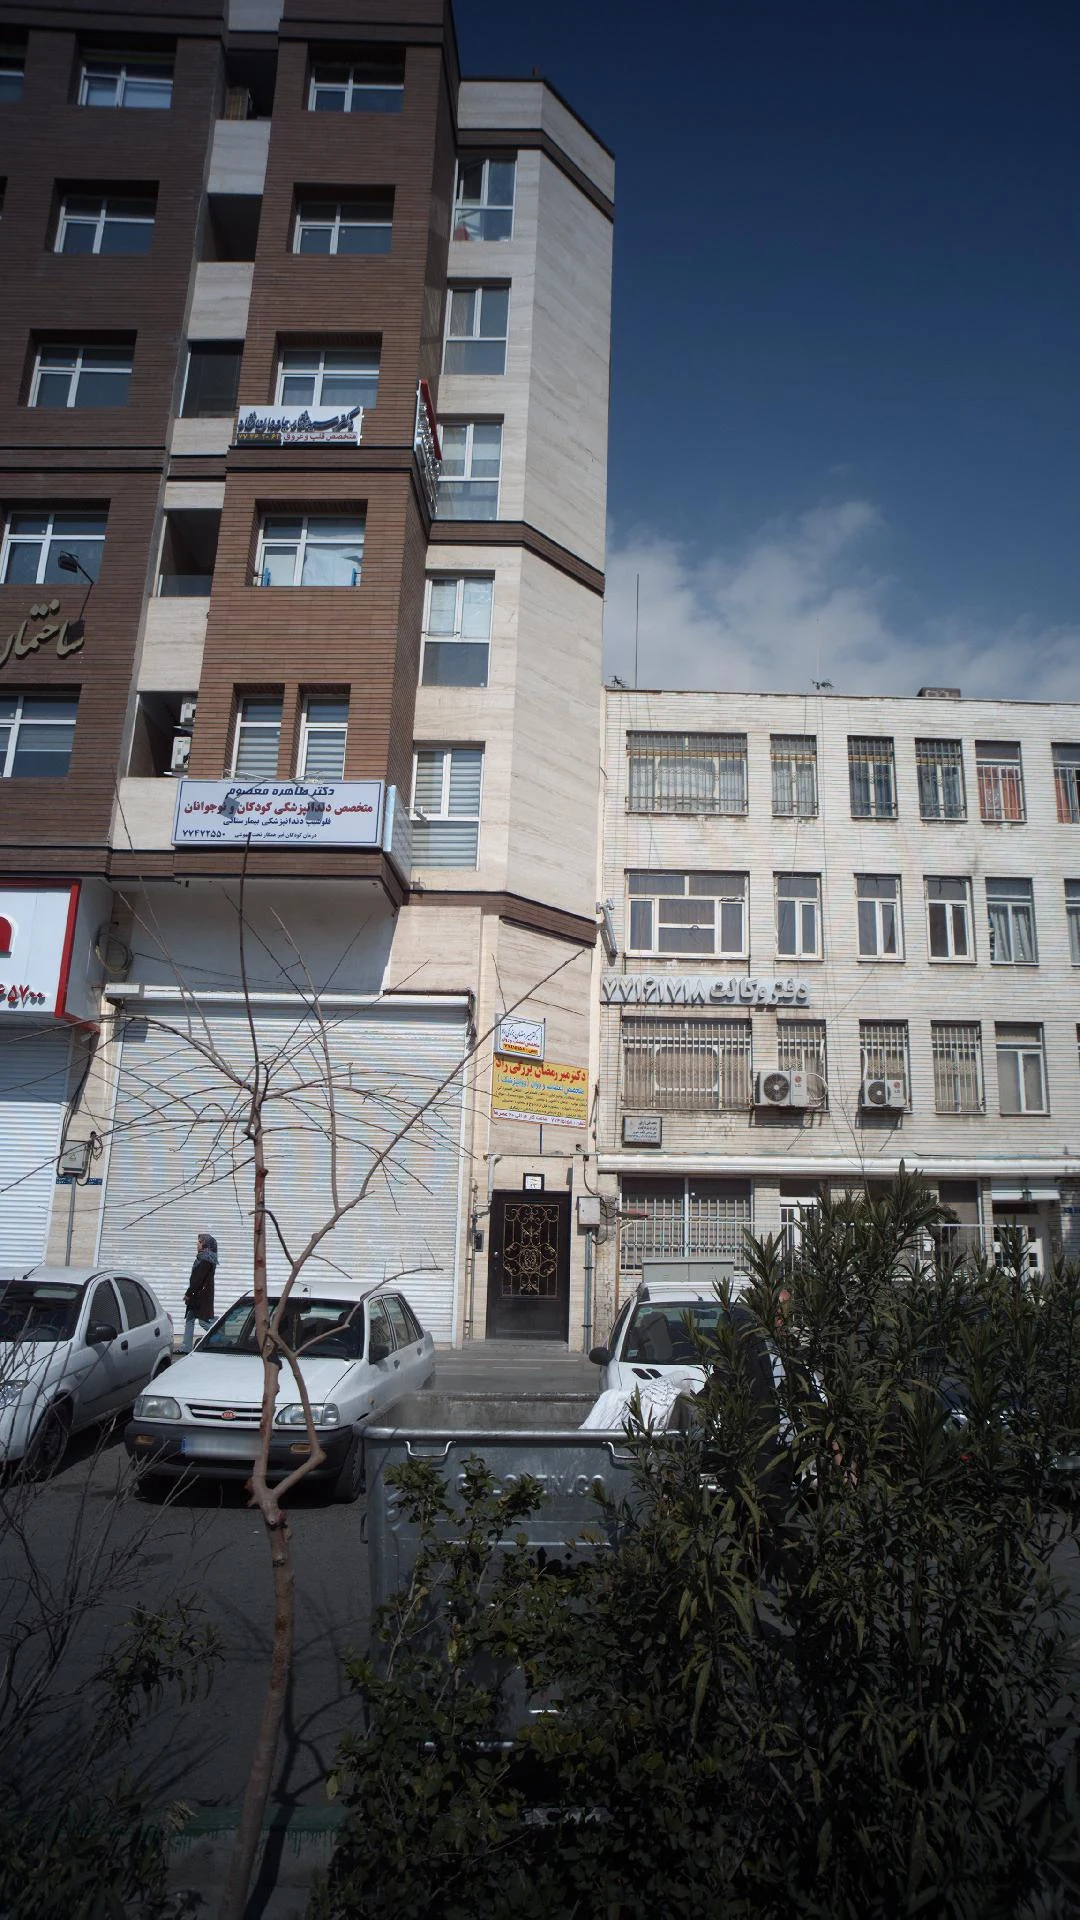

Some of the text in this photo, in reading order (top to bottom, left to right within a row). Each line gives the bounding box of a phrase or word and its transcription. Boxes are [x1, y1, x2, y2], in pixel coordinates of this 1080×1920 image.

[332, 406, 360, 432] دکتر
[283, 434, 303, 442] عروق
[310, 432, 325, 441] قلب
[326, 433, 357, 441] متخصص
[271, 786, 308, 796] طاهره
[308, 786, 335, 798] دکتر
[184, 800, 373, 816] متخصص دندانپزشکی کودکان و نوجوانان
[223, 816, 260, 826] بیمارستانی
[261, 816, 304, 826] دندانپزشکی
[182, 829, 226, 838] ۷۷۴۷۲۵۵۰
[601, 976, 810, 1005] دفتر وکالت ۷۷۱۶۱۷۱۸
[534, 1064, 558, 1081] رمضان
[569, 1069, 586, 1083] دکتر
